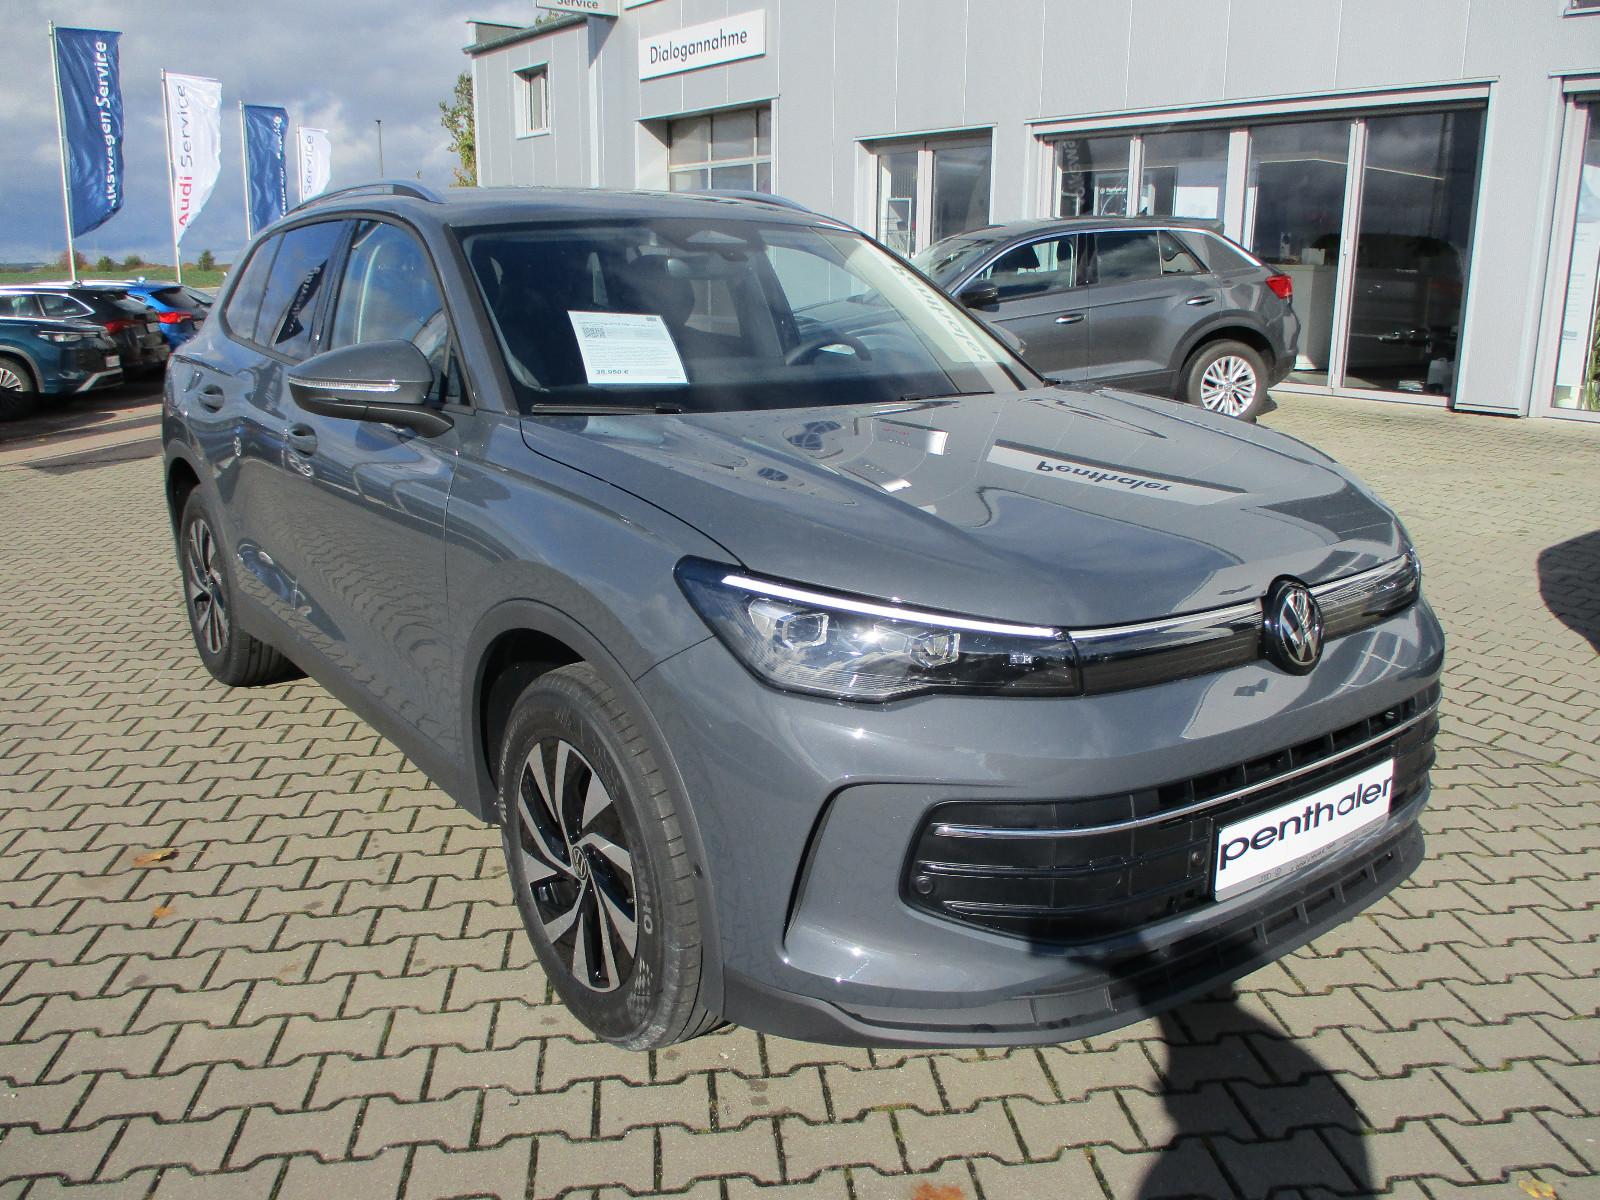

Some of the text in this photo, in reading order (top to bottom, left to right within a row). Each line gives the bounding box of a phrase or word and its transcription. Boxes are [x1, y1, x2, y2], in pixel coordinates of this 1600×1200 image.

[94, 41, 111, 109] Service
[650, 28, 748, 65] Dialogannahme
[176, 84, 194, 226] Audi Service
[1218, 776, 1394, 871] penthaler
